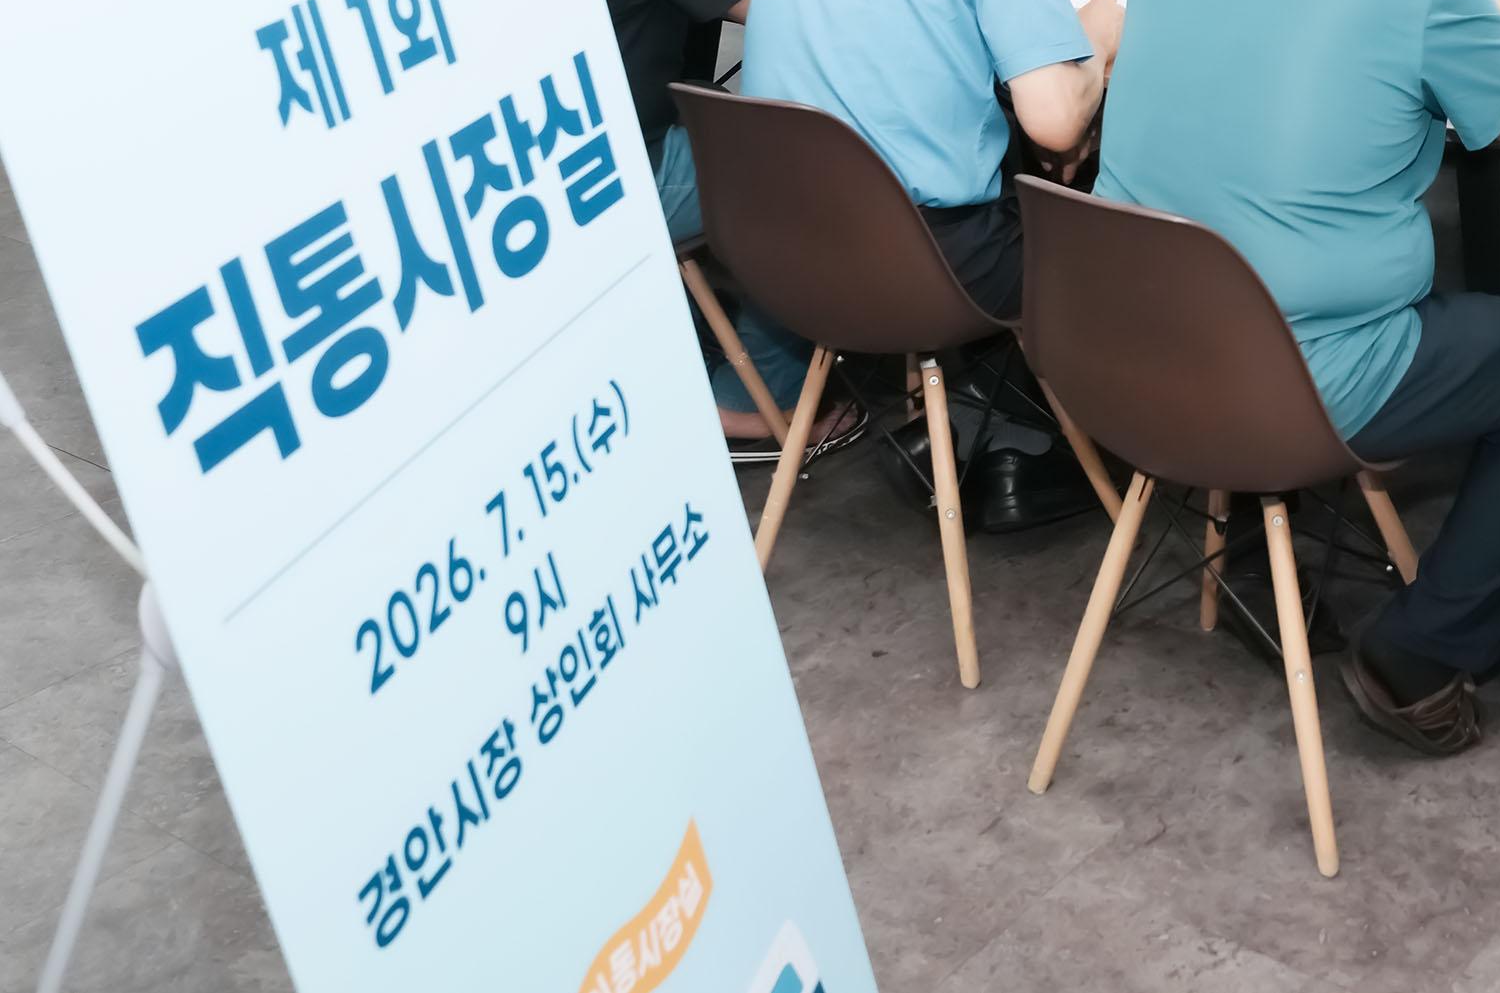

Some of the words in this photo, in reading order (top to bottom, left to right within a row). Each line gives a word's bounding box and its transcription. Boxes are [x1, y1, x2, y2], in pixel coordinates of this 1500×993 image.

[135, 51, 624, 475] 직통시장실
[355, 537, 486, 695] 2026.
[485, 489, 523, 557] 7.
[523, 379, 629, 518] 15.(수)
[505, 552, 567, 654] 9시
[358, 718, 522, 949] 경안시장
[529, 594, 625, 745] 상인회
[632, 502, 709, 624] 사무소
